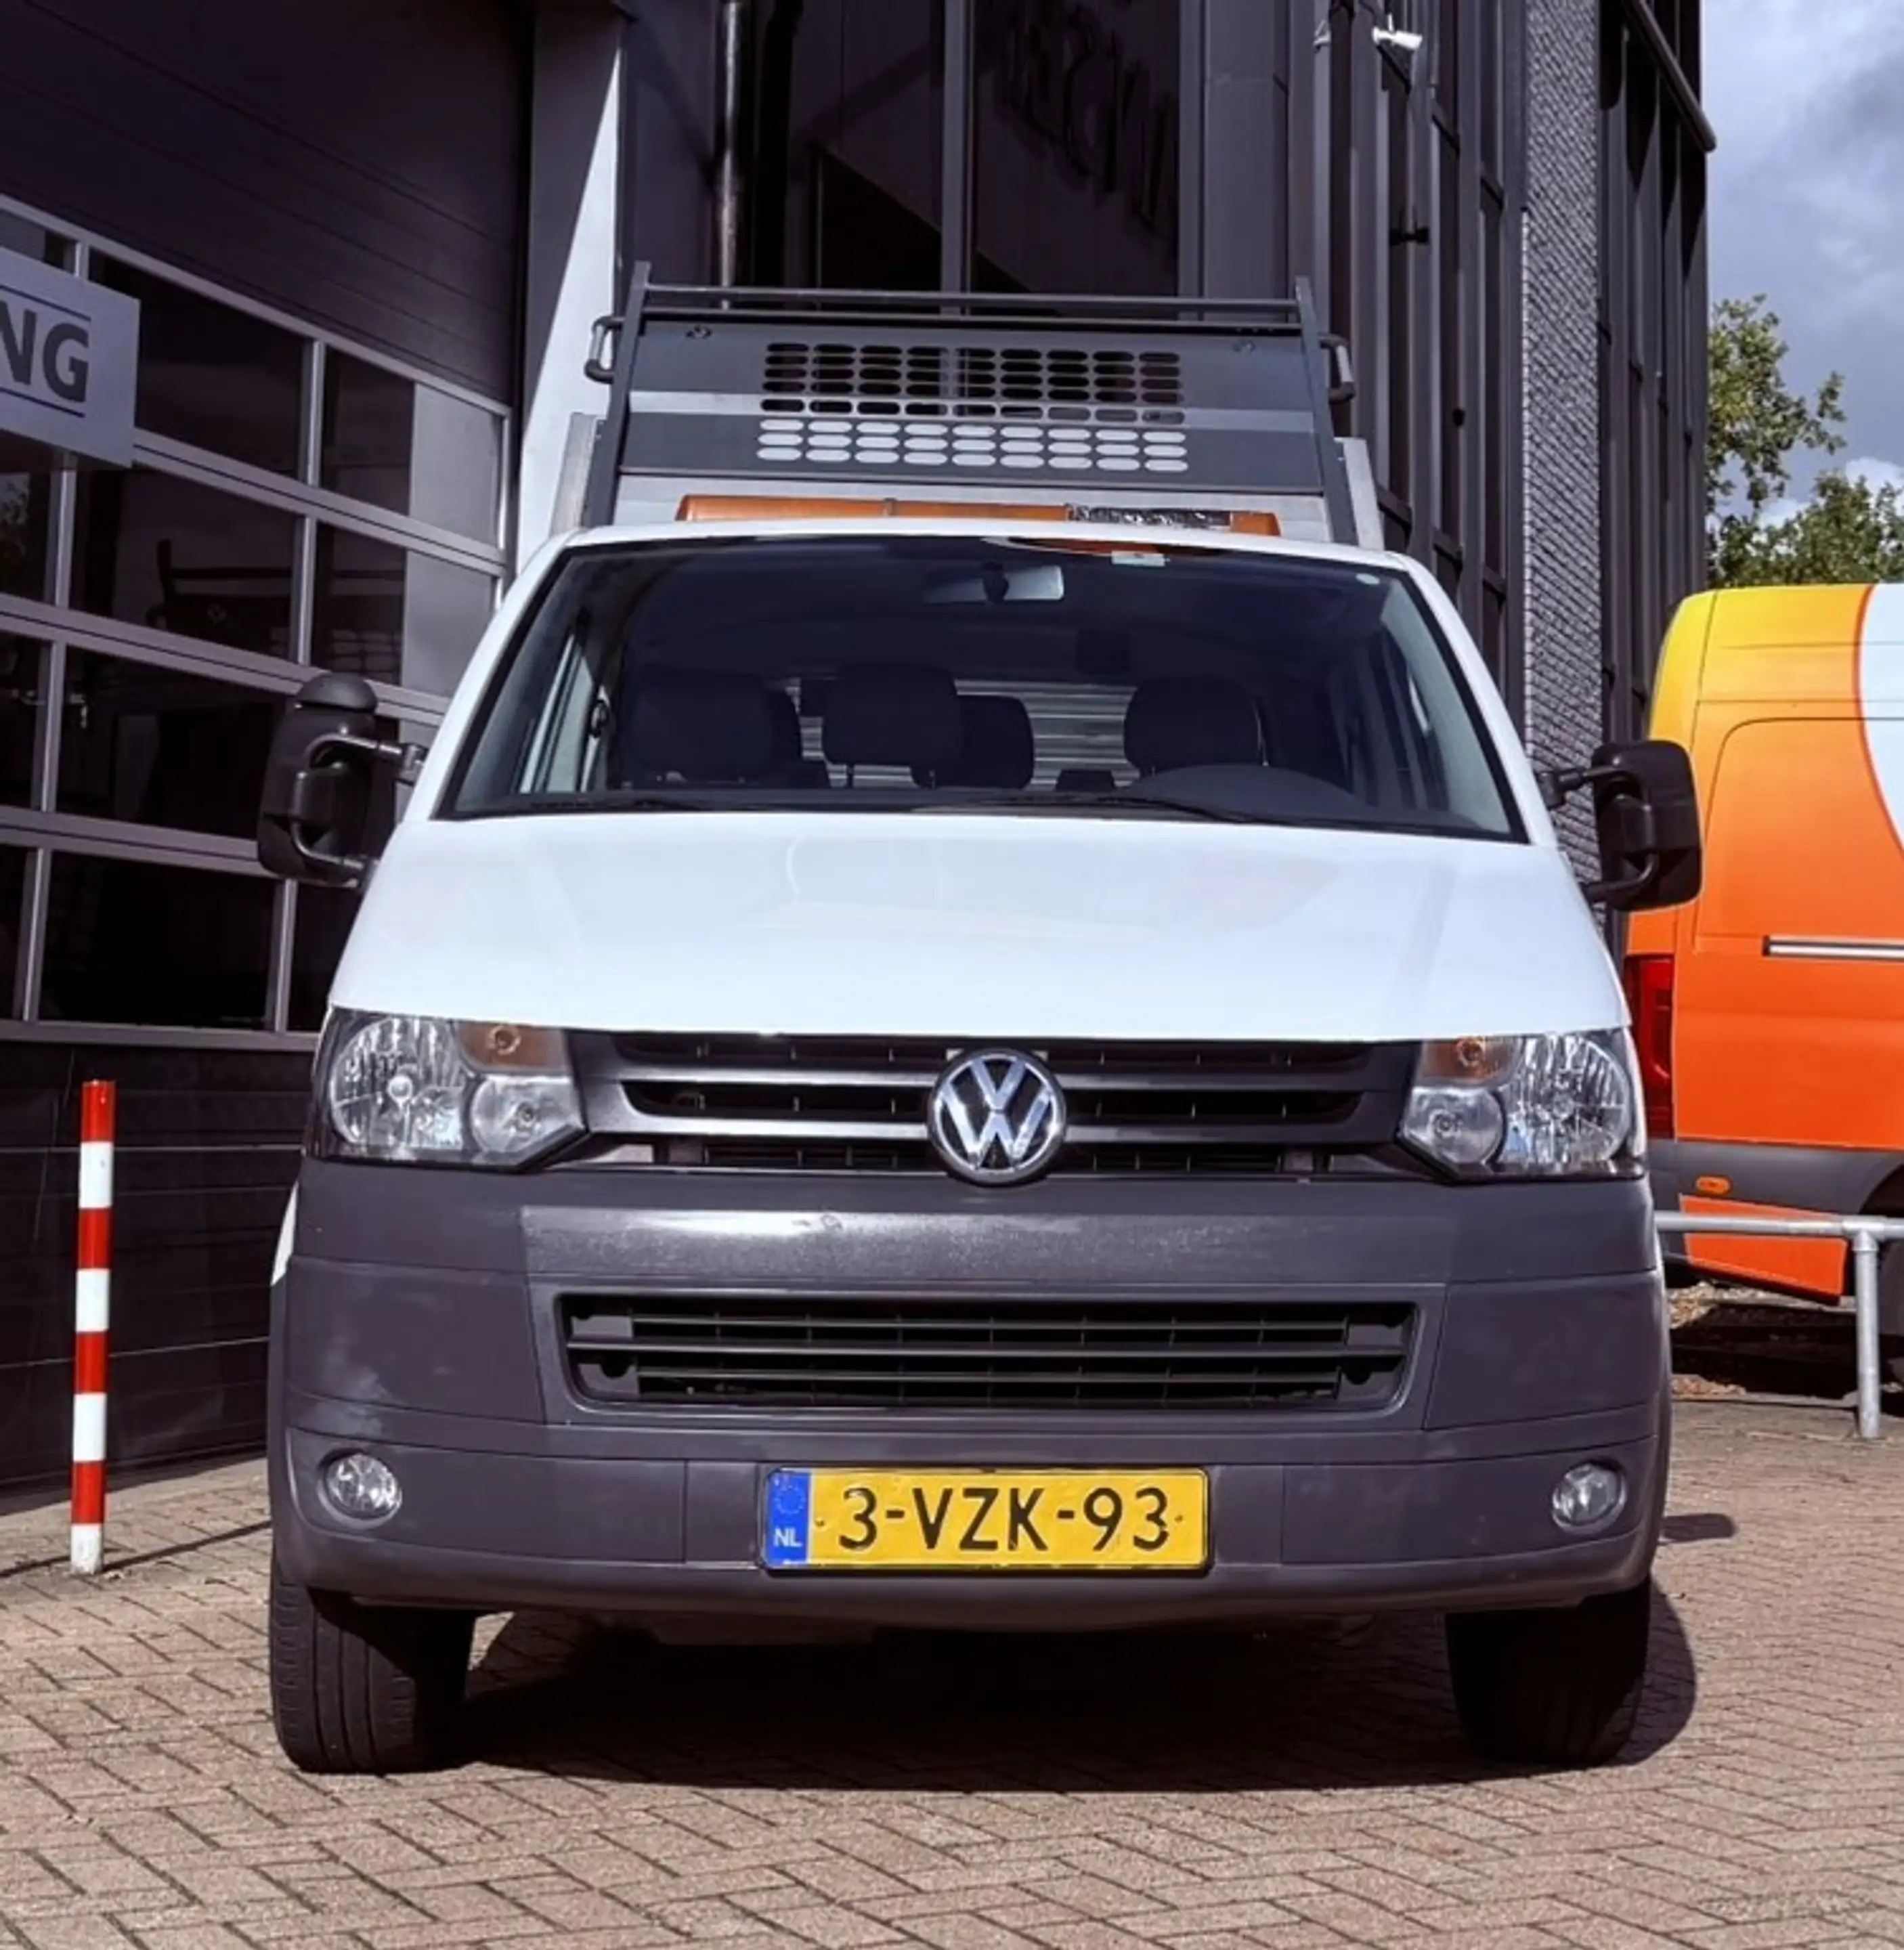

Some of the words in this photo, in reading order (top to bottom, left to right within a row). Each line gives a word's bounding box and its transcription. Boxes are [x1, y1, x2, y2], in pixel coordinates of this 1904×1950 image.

[0, 300, 89, 403] NG
[938, 1056, 1055, 1172] VW
[773, 1527, 804, 1548] NL
[838, 1486, 1169, 1551] 3-VZK-93
